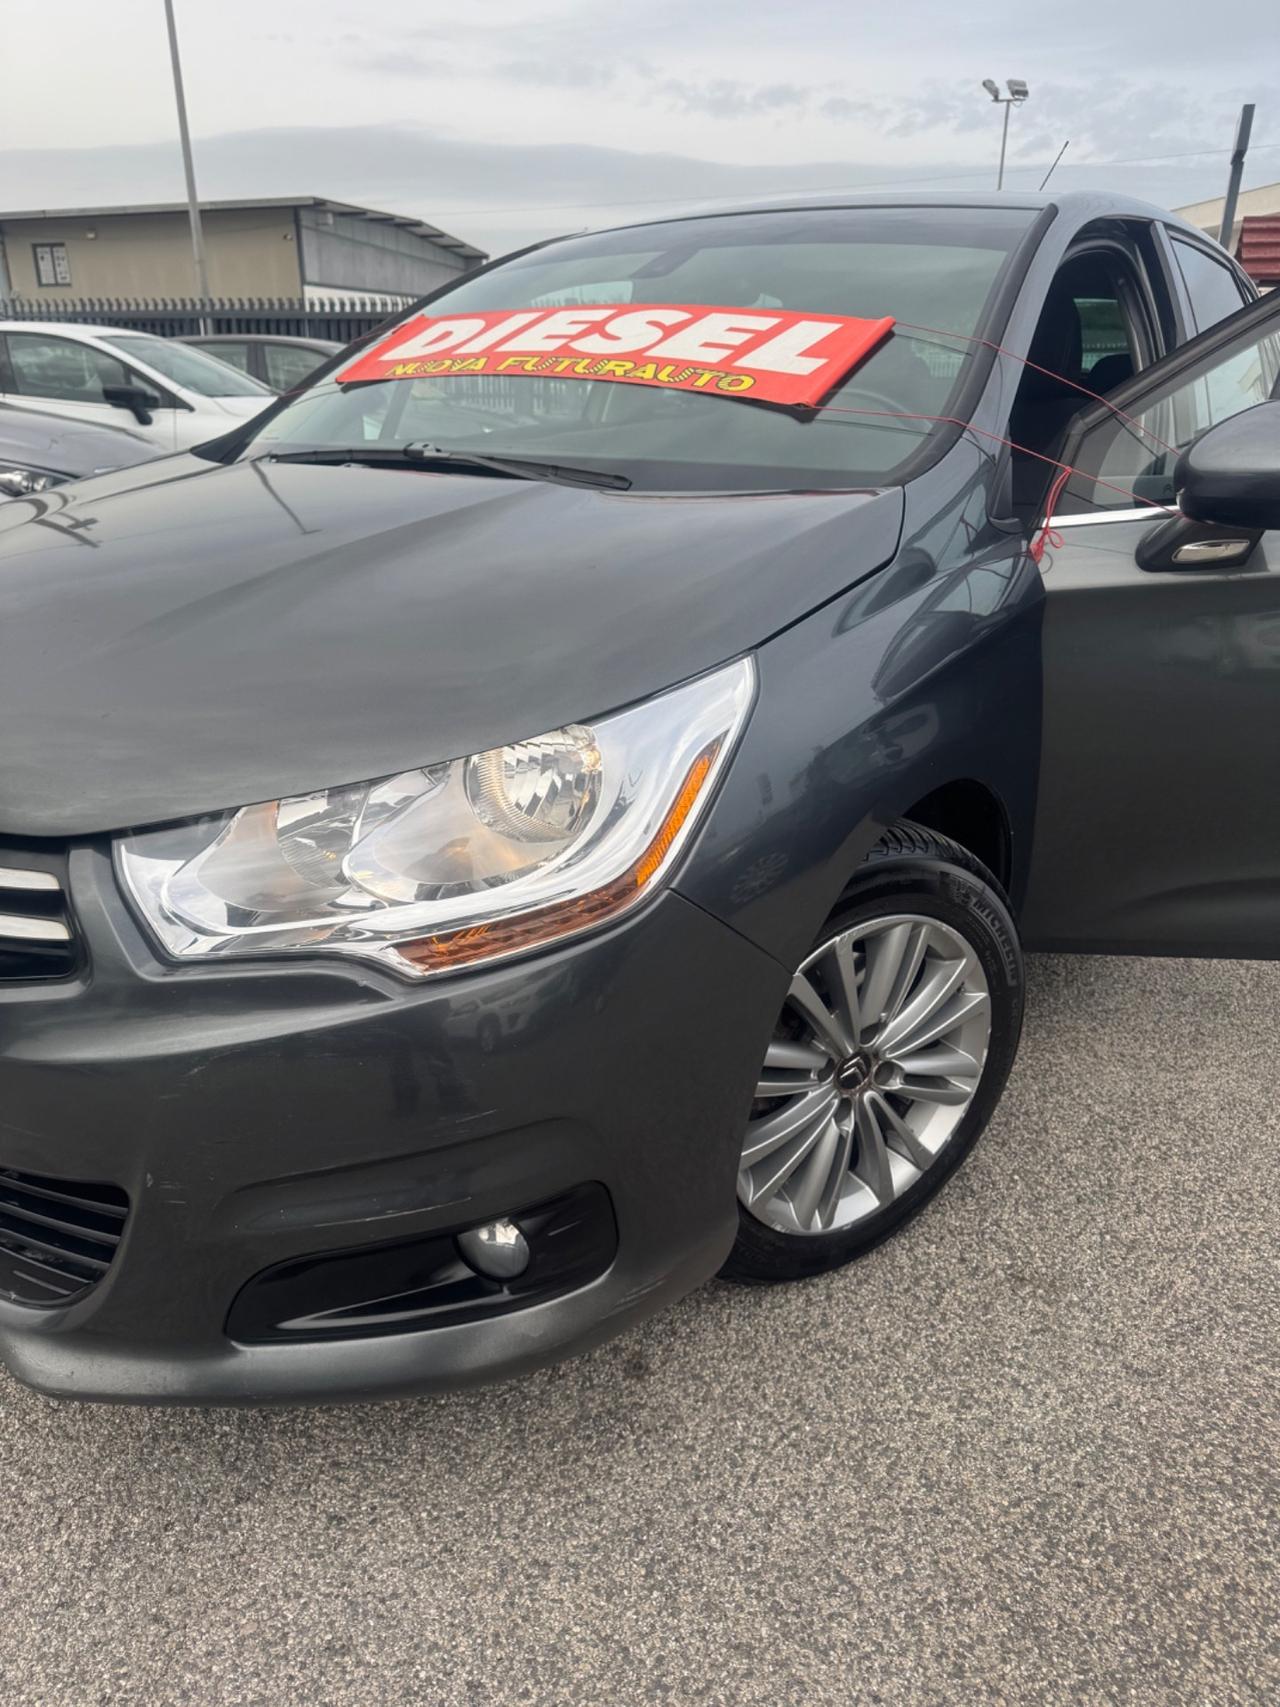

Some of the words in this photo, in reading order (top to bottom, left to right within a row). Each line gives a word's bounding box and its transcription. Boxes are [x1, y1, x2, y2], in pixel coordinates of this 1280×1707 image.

[379, 308, 844, 376] DIESEL
[385, 357, 488, 376] NUOVA
[495, 356, 756, 392] FUTURAUTO
[970, 896, 1018, 984] MICHELIN
